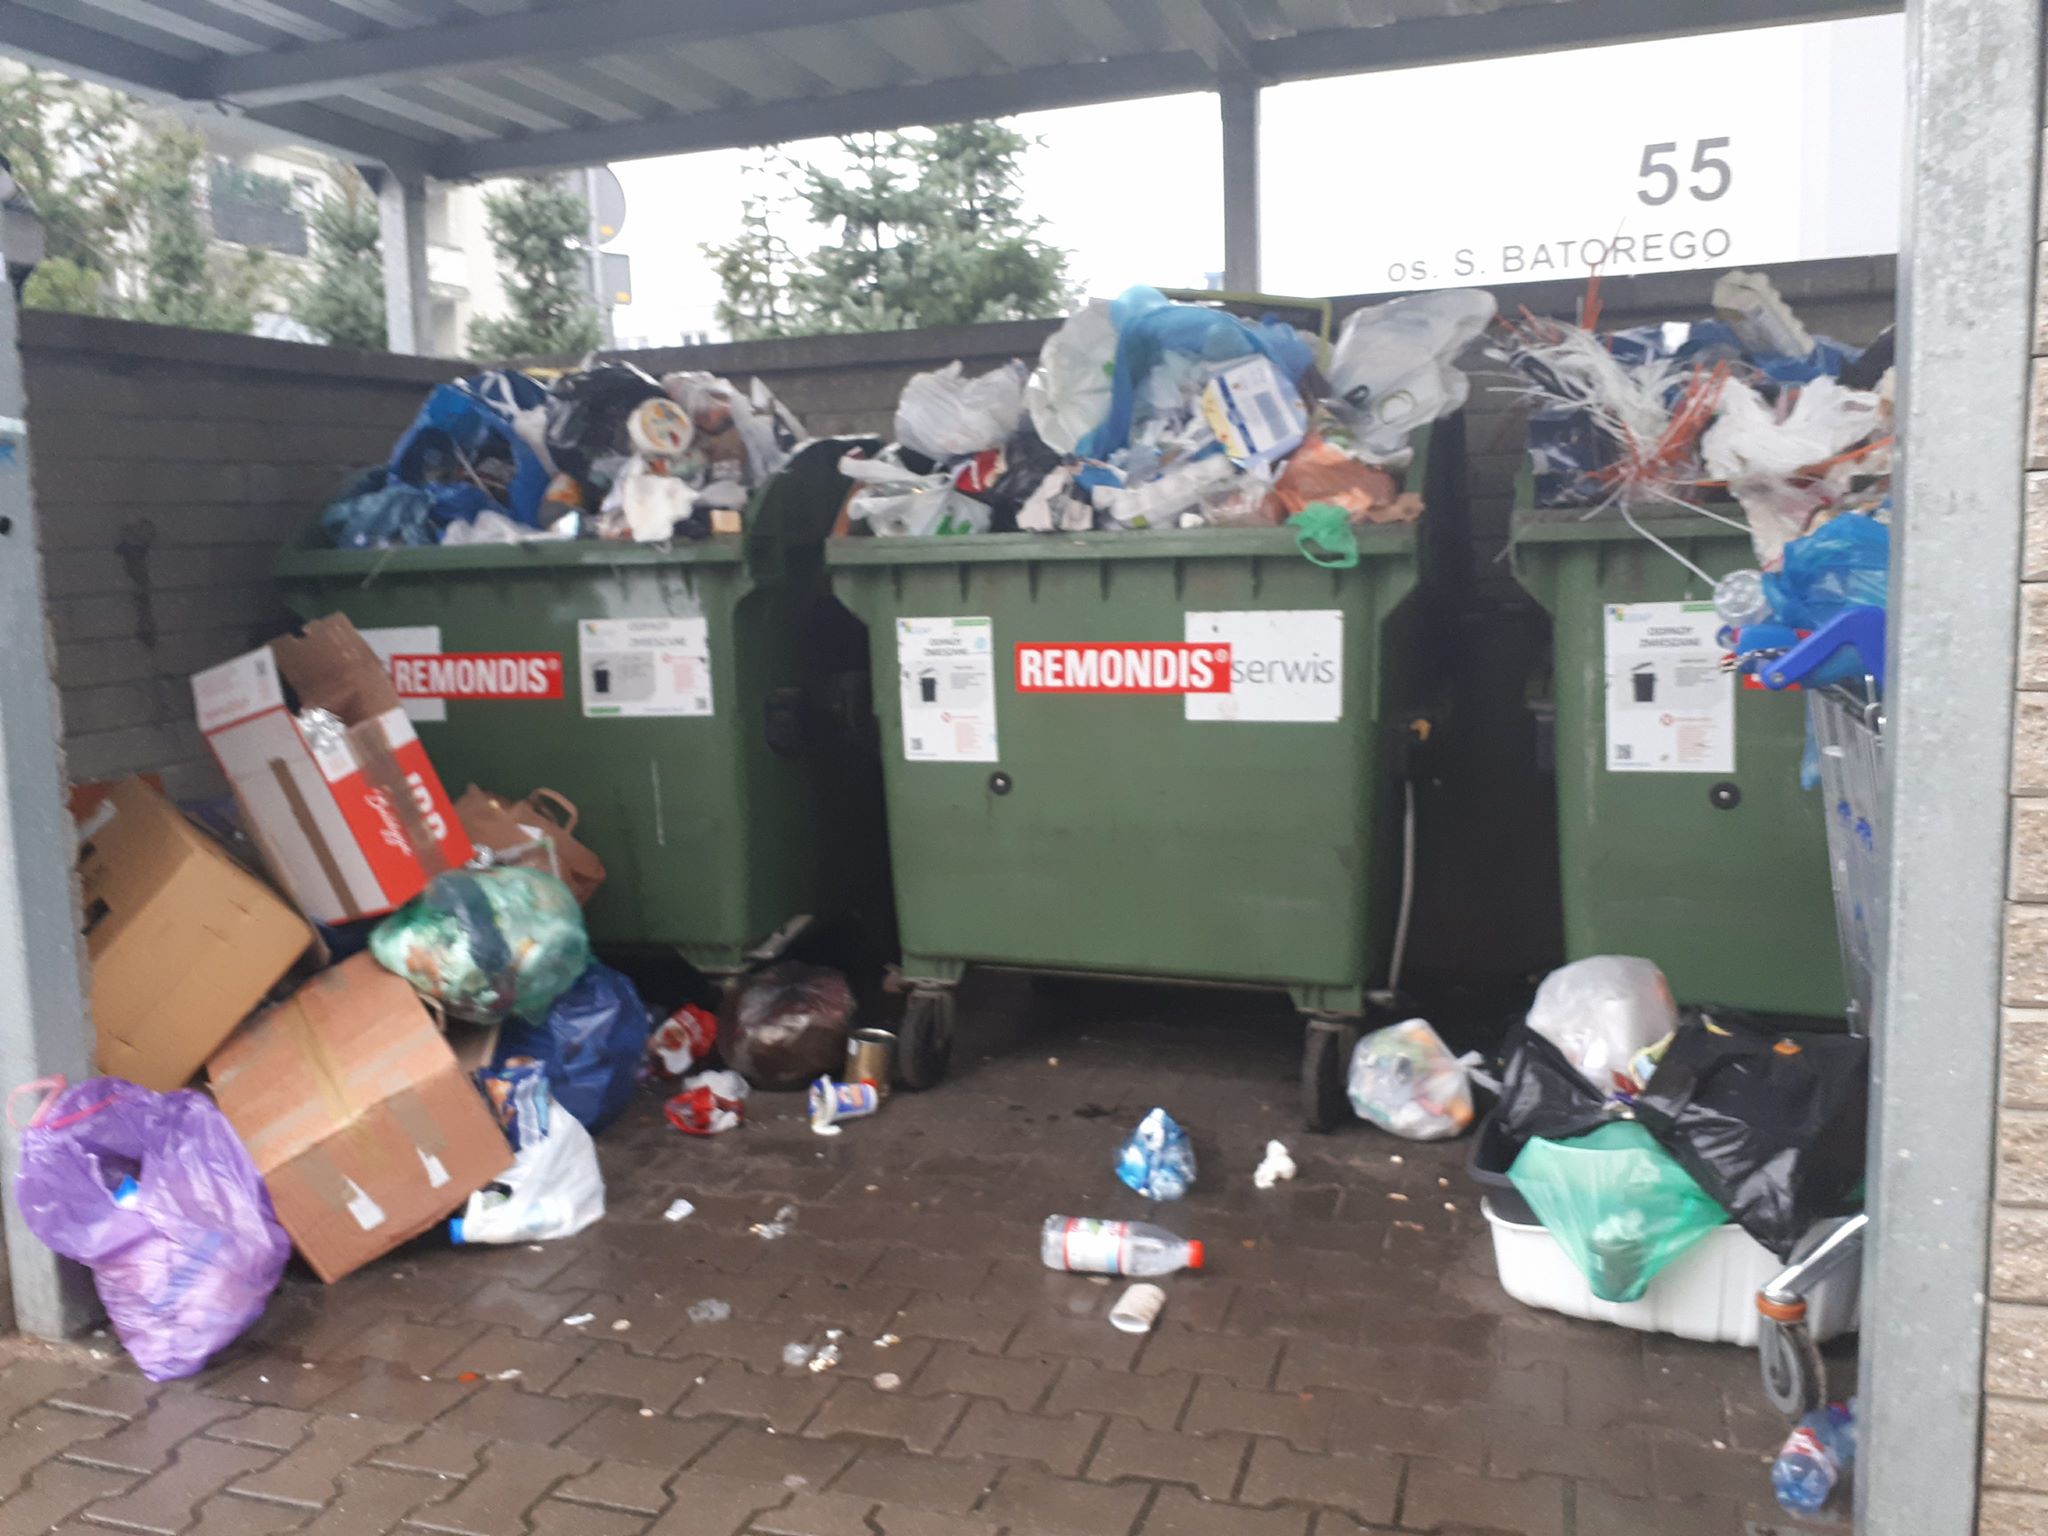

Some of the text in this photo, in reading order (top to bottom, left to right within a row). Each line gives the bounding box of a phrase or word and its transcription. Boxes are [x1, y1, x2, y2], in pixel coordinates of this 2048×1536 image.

[1637, 136, 1732, 207] 55
[1387, 228, 1731, 283] os. S. BATOREGO
[1231, 652, 1335, 684] serwis
